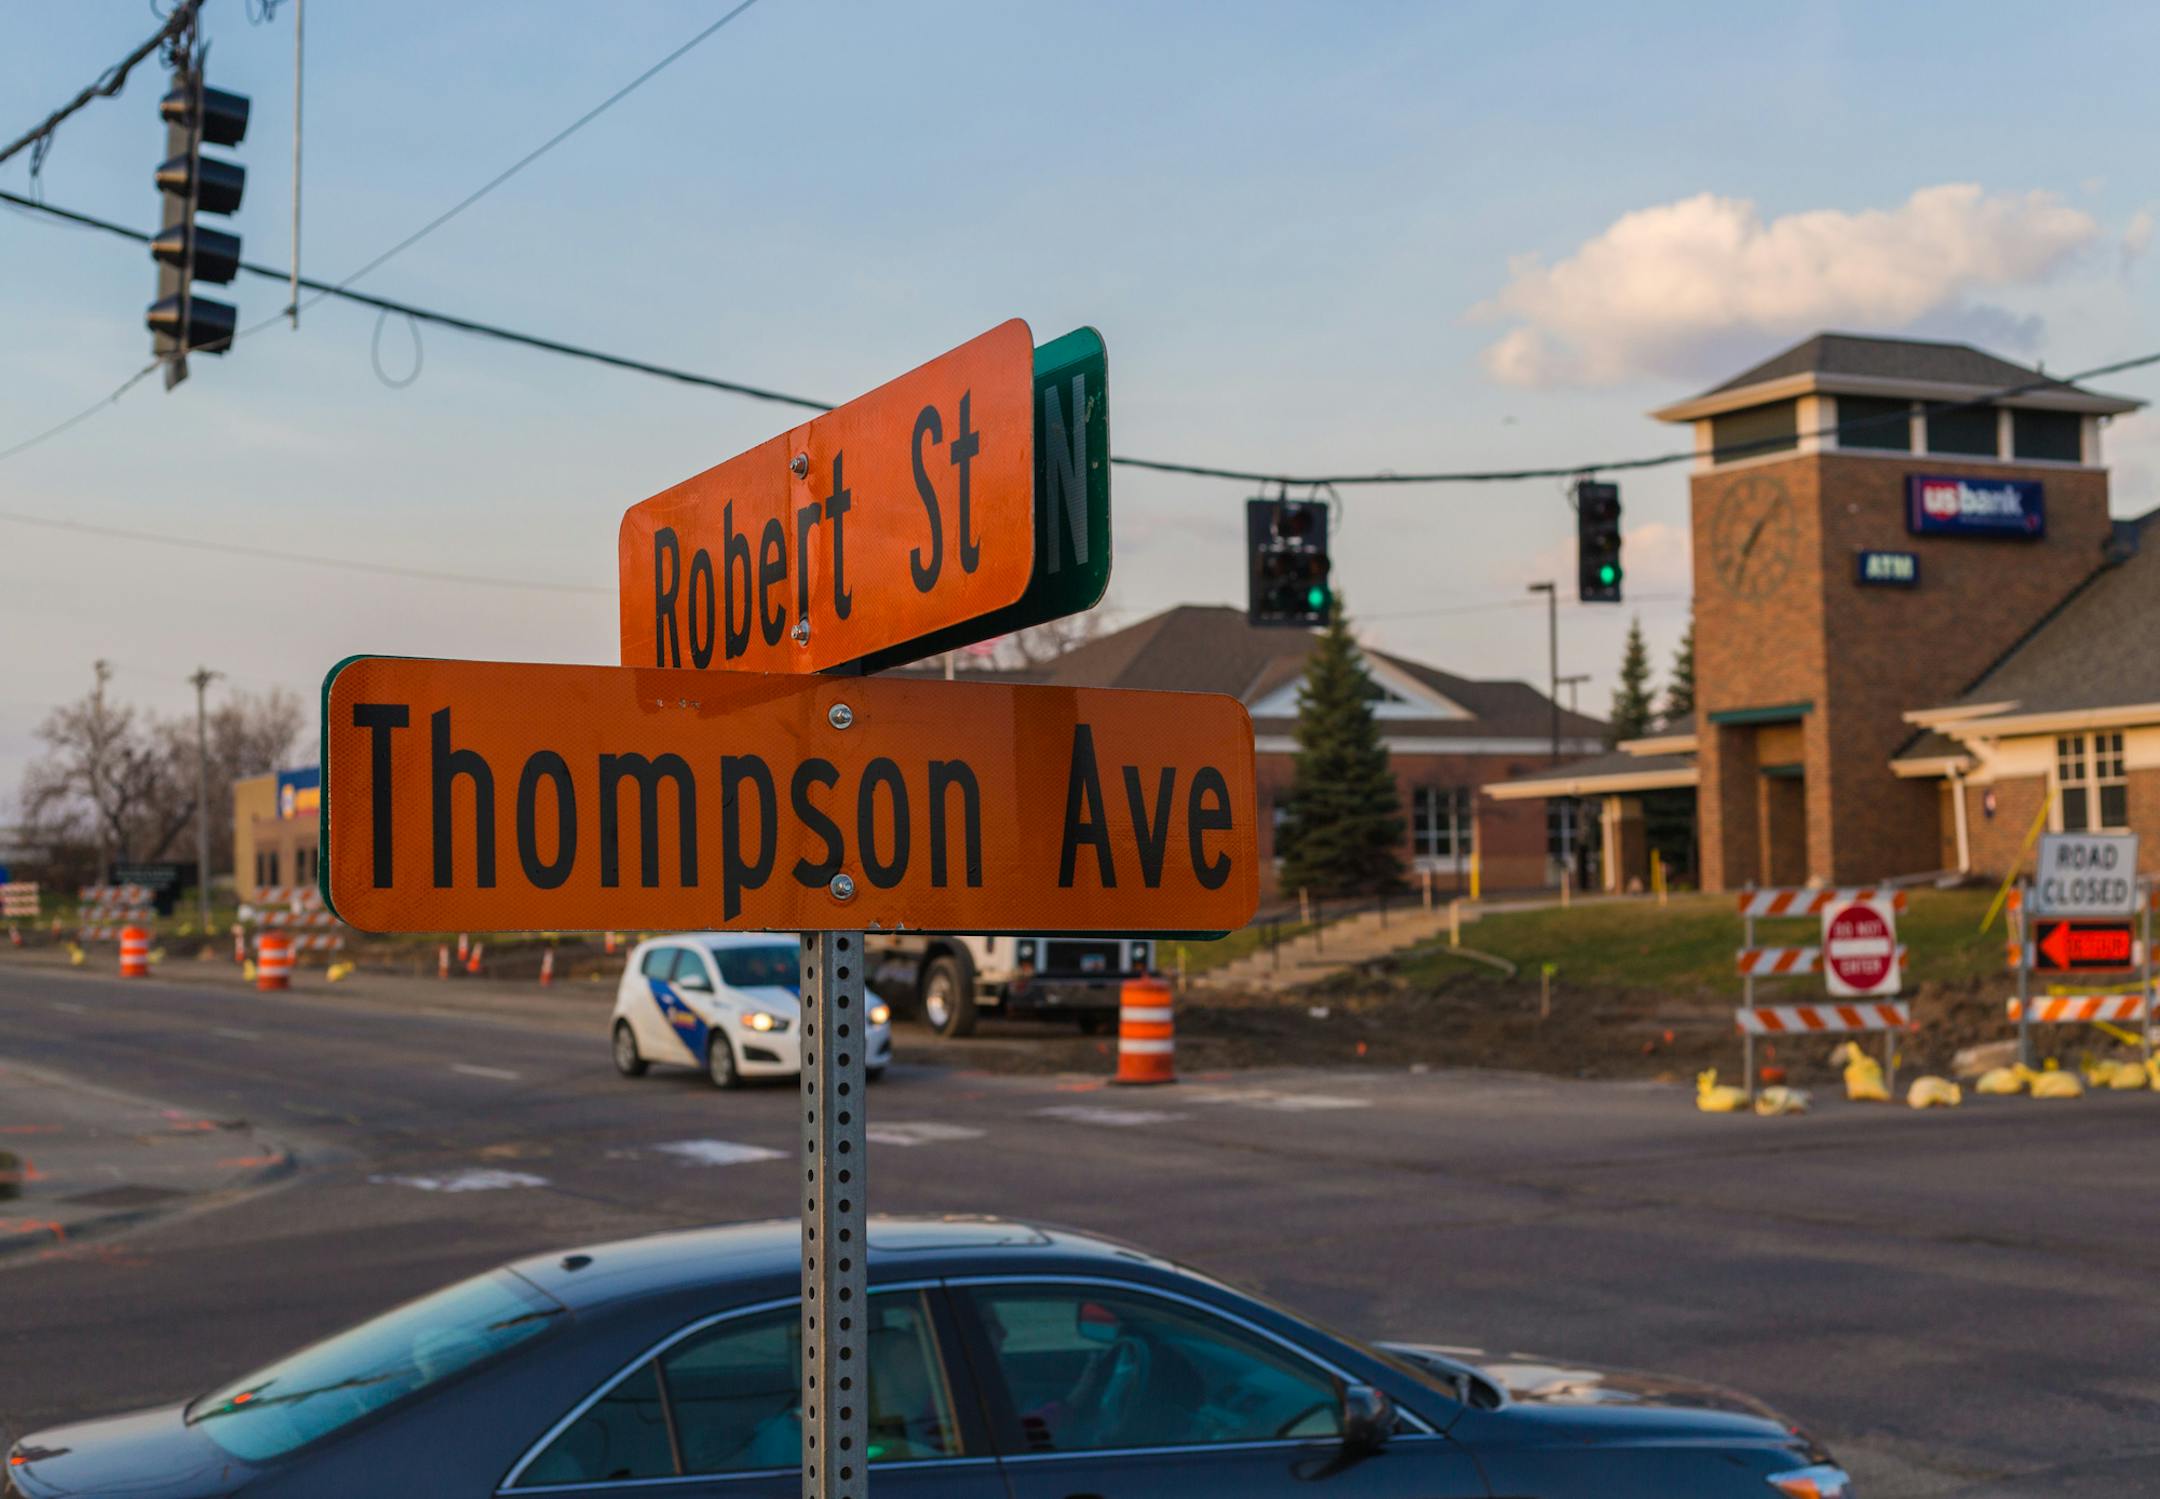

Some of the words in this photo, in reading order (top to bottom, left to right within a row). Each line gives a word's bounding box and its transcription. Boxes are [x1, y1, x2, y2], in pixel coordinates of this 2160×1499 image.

[654, 449, 852, 669] Robert
[910, 389, 979, 593] St
[1044, 373, 1089, 574] N
[1866, 554, 1914, 578] ATM
[353, 703, 983, 922] Thompson
[1058, 724, 1232, 890] Ave
[2056, 844, 2118, 870] ROAD
[2043, 878, 2128, 905] CLOSED
